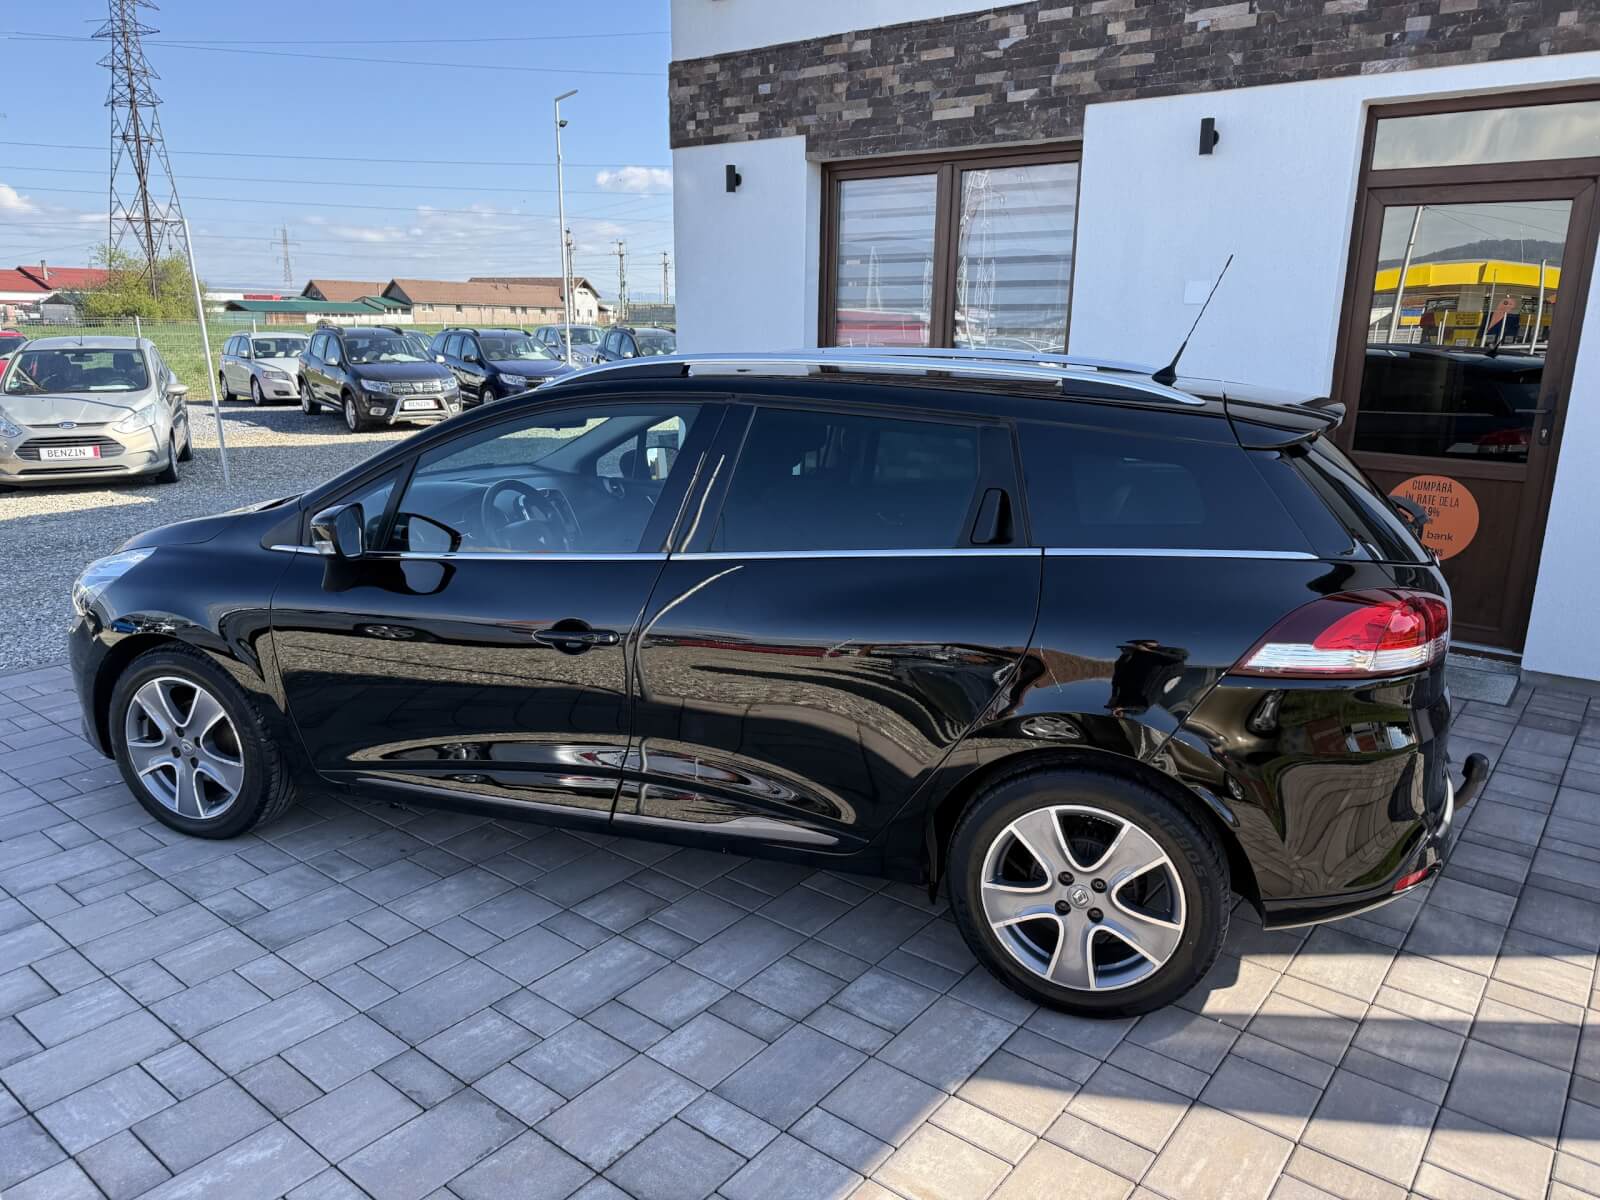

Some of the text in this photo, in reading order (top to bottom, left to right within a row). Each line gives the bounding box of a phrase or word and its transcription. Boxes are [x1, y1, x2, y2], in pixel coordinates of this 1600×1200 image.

[47, 448, 86, 458] BENZIN
[1416, 493, 1437, 506] RATE
[1439, 496, 1449, 507] DE
[1450, 496, 1459, 508] LA
[1427, 530, 1453, 541] bank
